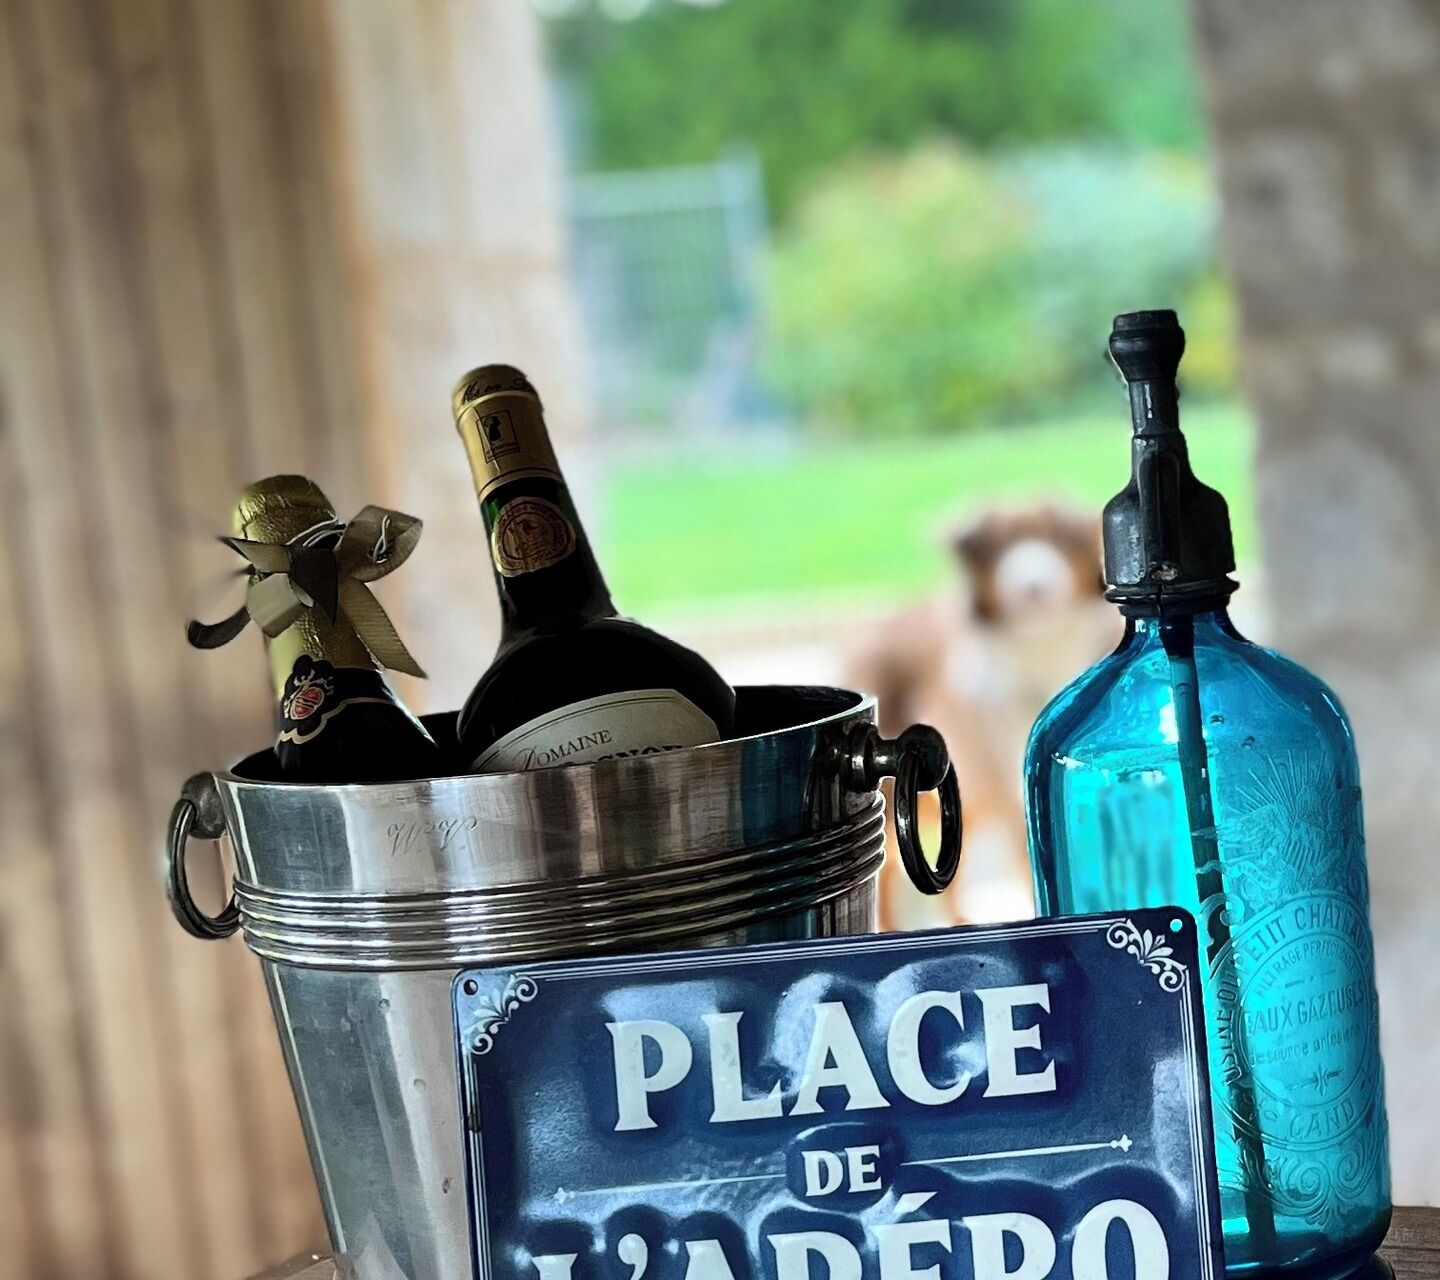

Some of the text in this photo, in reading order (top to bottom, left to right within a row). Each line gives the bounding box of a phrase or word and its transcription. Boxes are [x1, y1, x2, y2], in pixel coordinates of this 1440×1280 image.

[1245, 1003, 1294, 1038] EAUX
[604, 981, 1057, 1132] PLACE
[800, 1144, 884, 1198] DE
